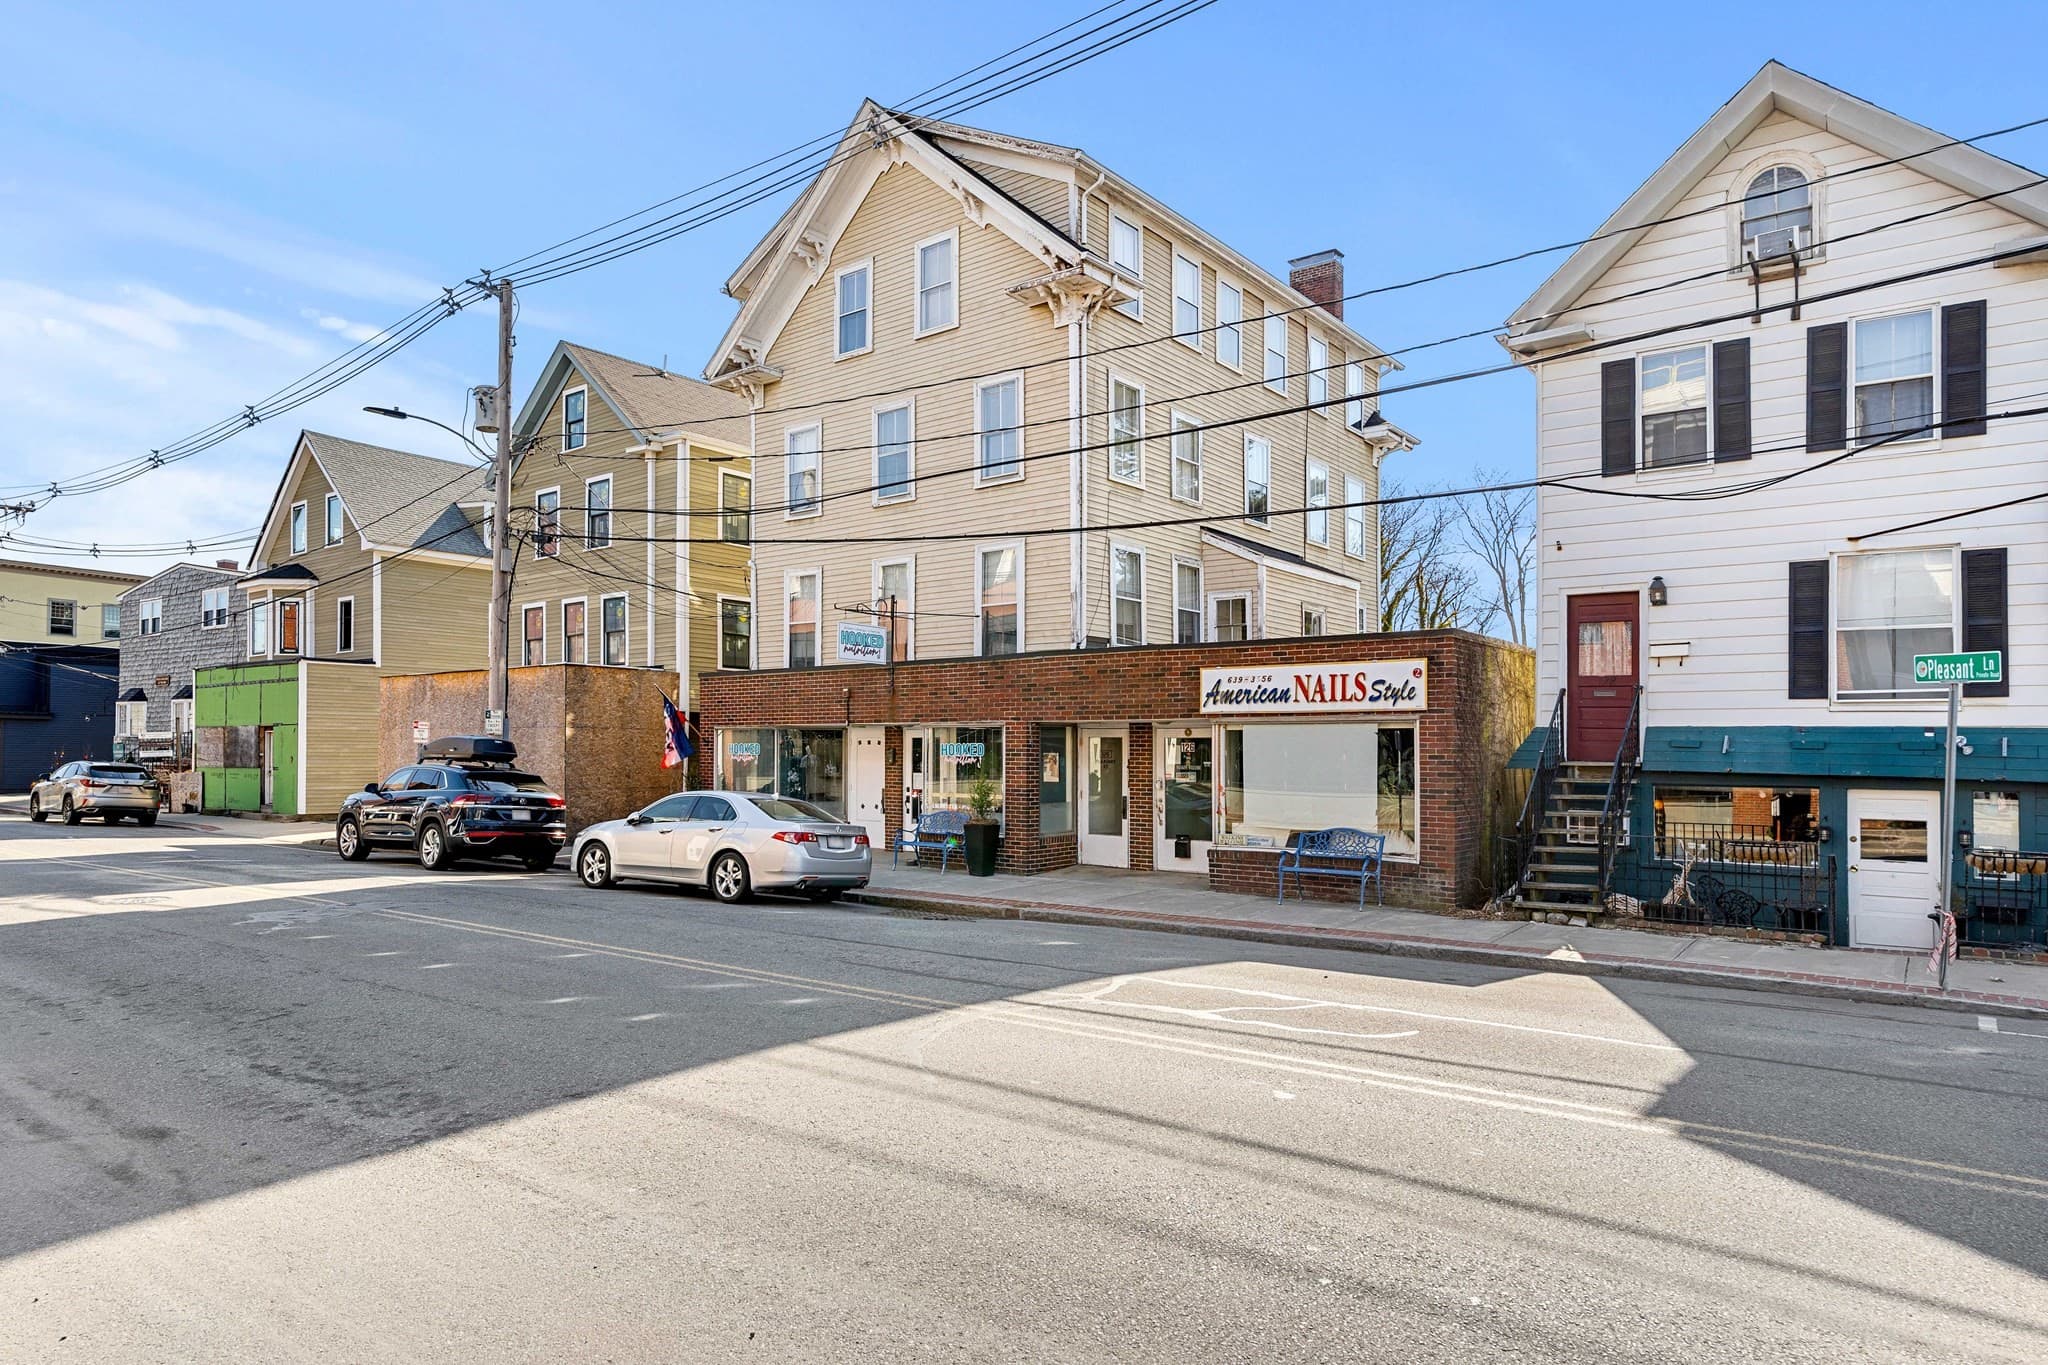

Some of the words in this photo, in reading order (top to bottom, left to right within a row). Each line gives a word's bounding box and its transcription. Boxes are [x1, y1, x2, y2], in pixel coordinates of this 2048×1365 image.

[840, 630, 884, 648] HOOKED
[843, 642, 880, 656] nutrition
[1927, 658, 1974, 680] Pleasant
[1983, 656, 1995, 671] Ln
[1227, 675, 1272, 684] 639-356
[1203, 679, 1291, 707] American
[1293, 672, 1367, 703] NAILS
[1369, 679, 1417, 706] Style
[728, 743, 760, 756] HOOKED
[940, 743, 984, 757] HOOKED
[1182, 743, 1195, 752] 126
